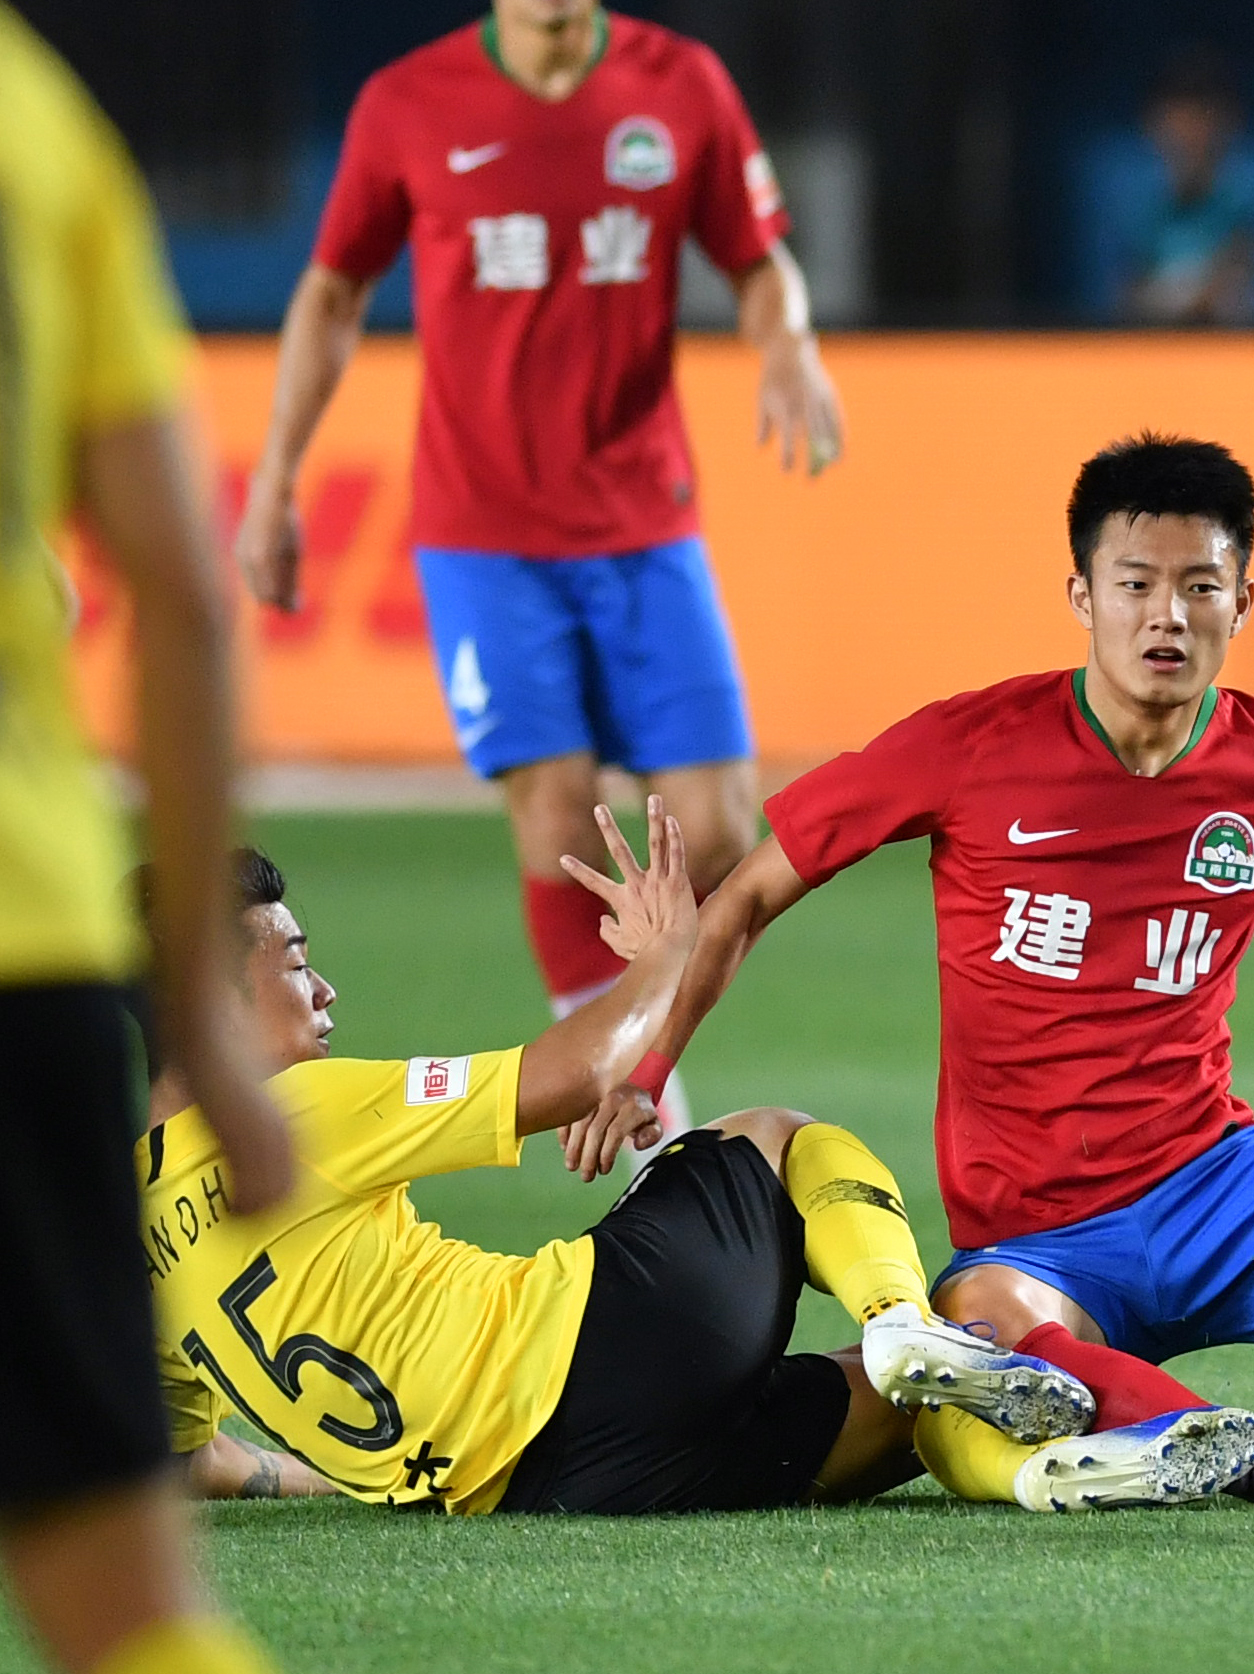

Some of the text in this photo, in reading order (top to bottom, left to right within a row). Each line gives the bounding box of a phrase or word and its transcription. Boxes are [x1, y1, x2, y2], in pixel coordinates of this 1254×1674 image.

[990, 888, 1222, 996] 建业
[424, 1060, 451, 1098] 恒大
[181, 1251, 403, 1492] 15
[387, 1440, 454, 1505] 大
